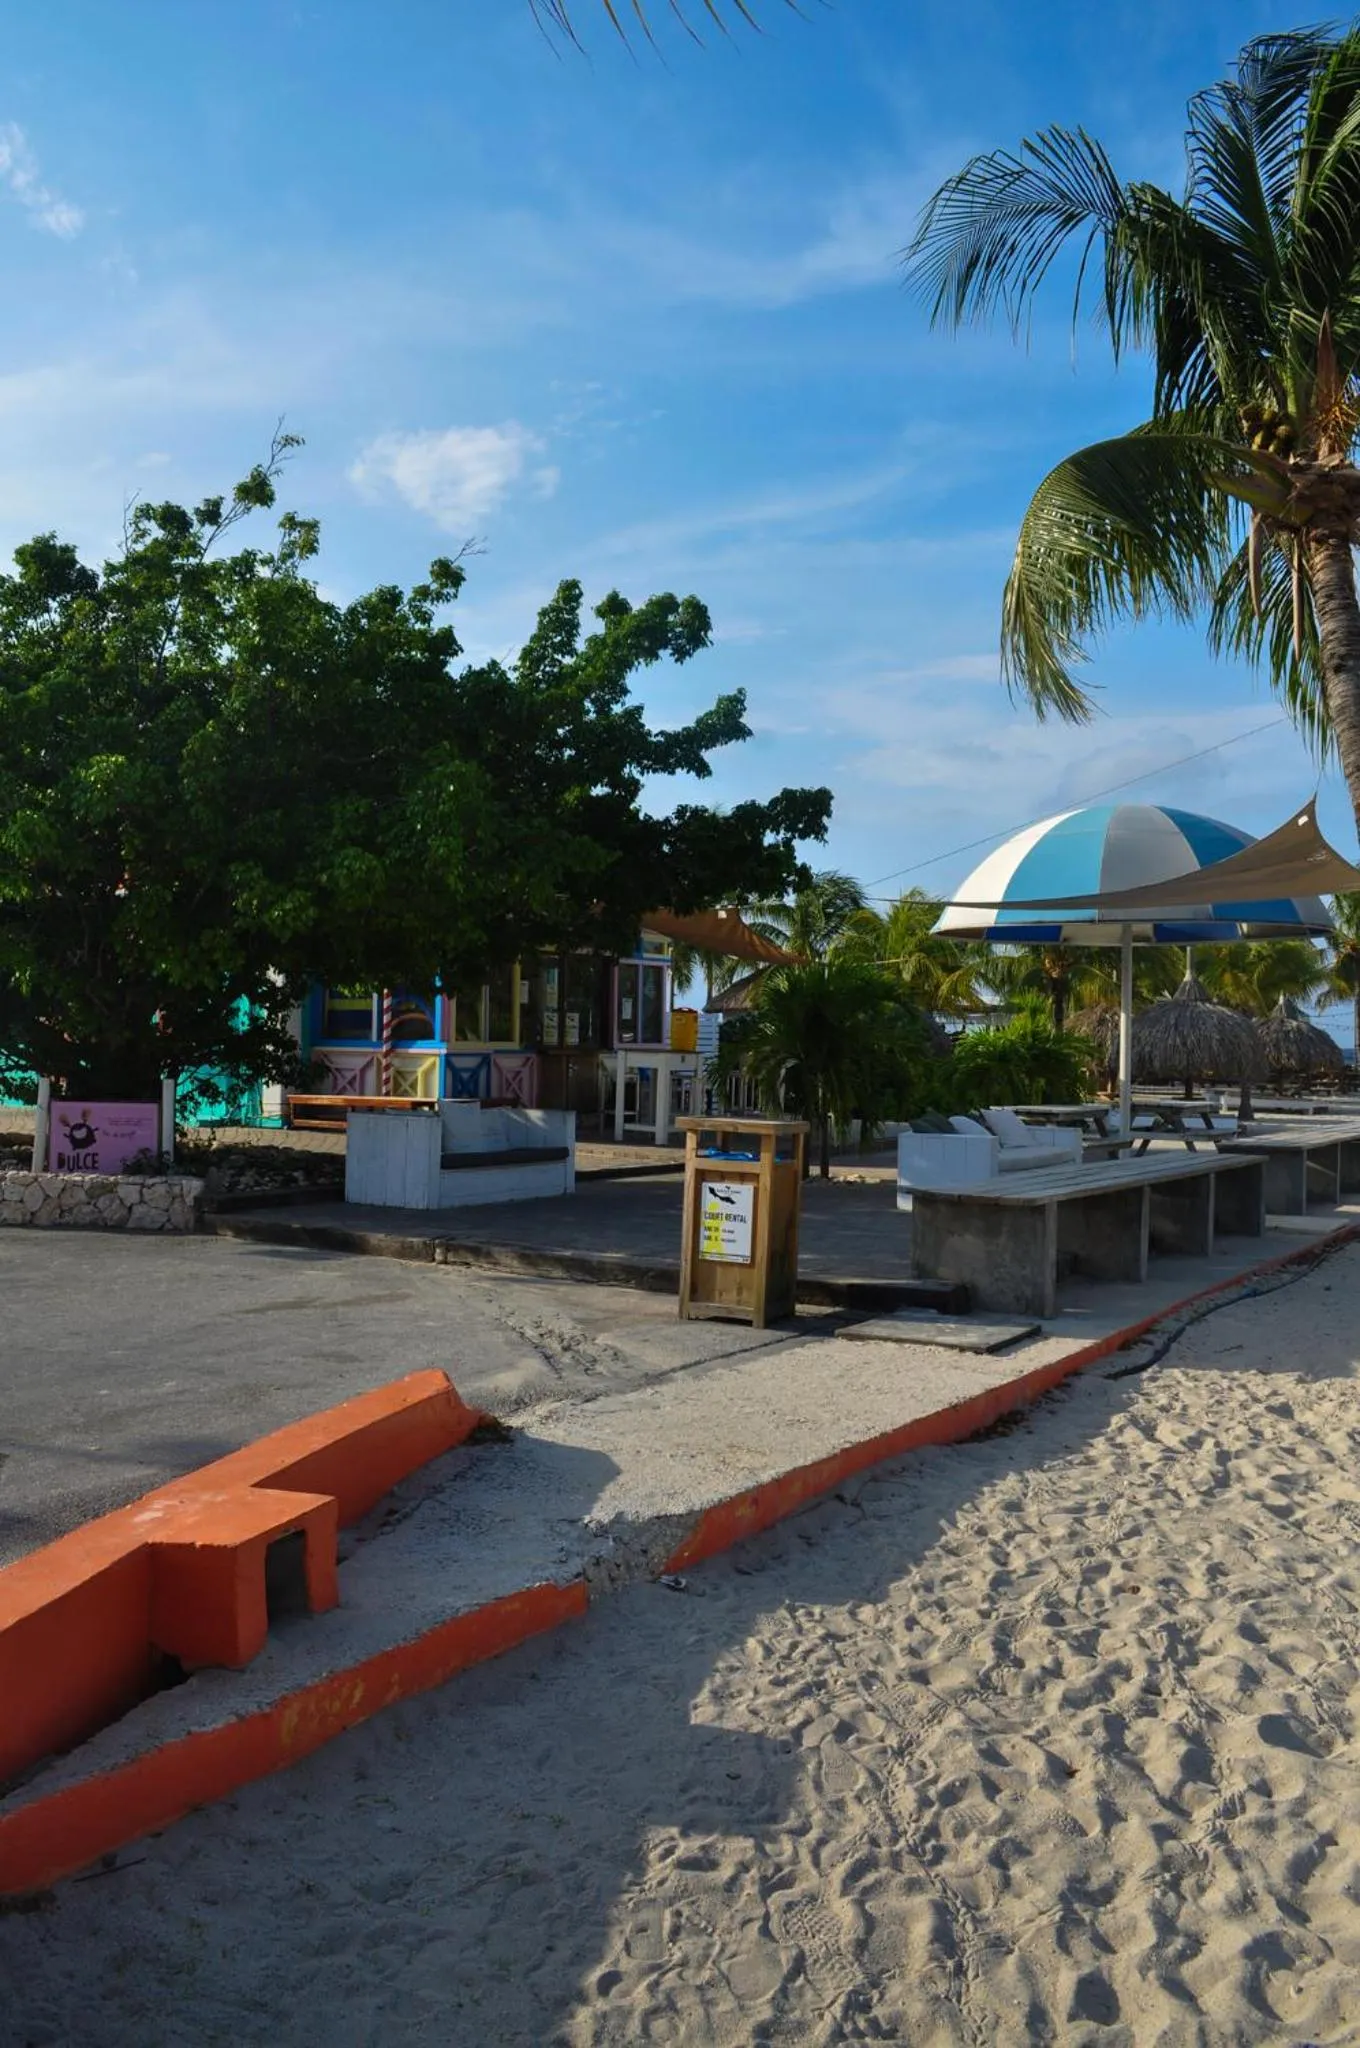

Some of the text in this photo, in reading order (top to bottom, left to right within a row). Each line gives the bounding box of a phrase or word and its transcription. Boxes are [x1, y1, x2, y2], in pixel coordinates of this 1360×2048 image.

[57, 1152, 99, 1171] DULCE
[704, 1211, 747, 1224] COURT RENTAL
